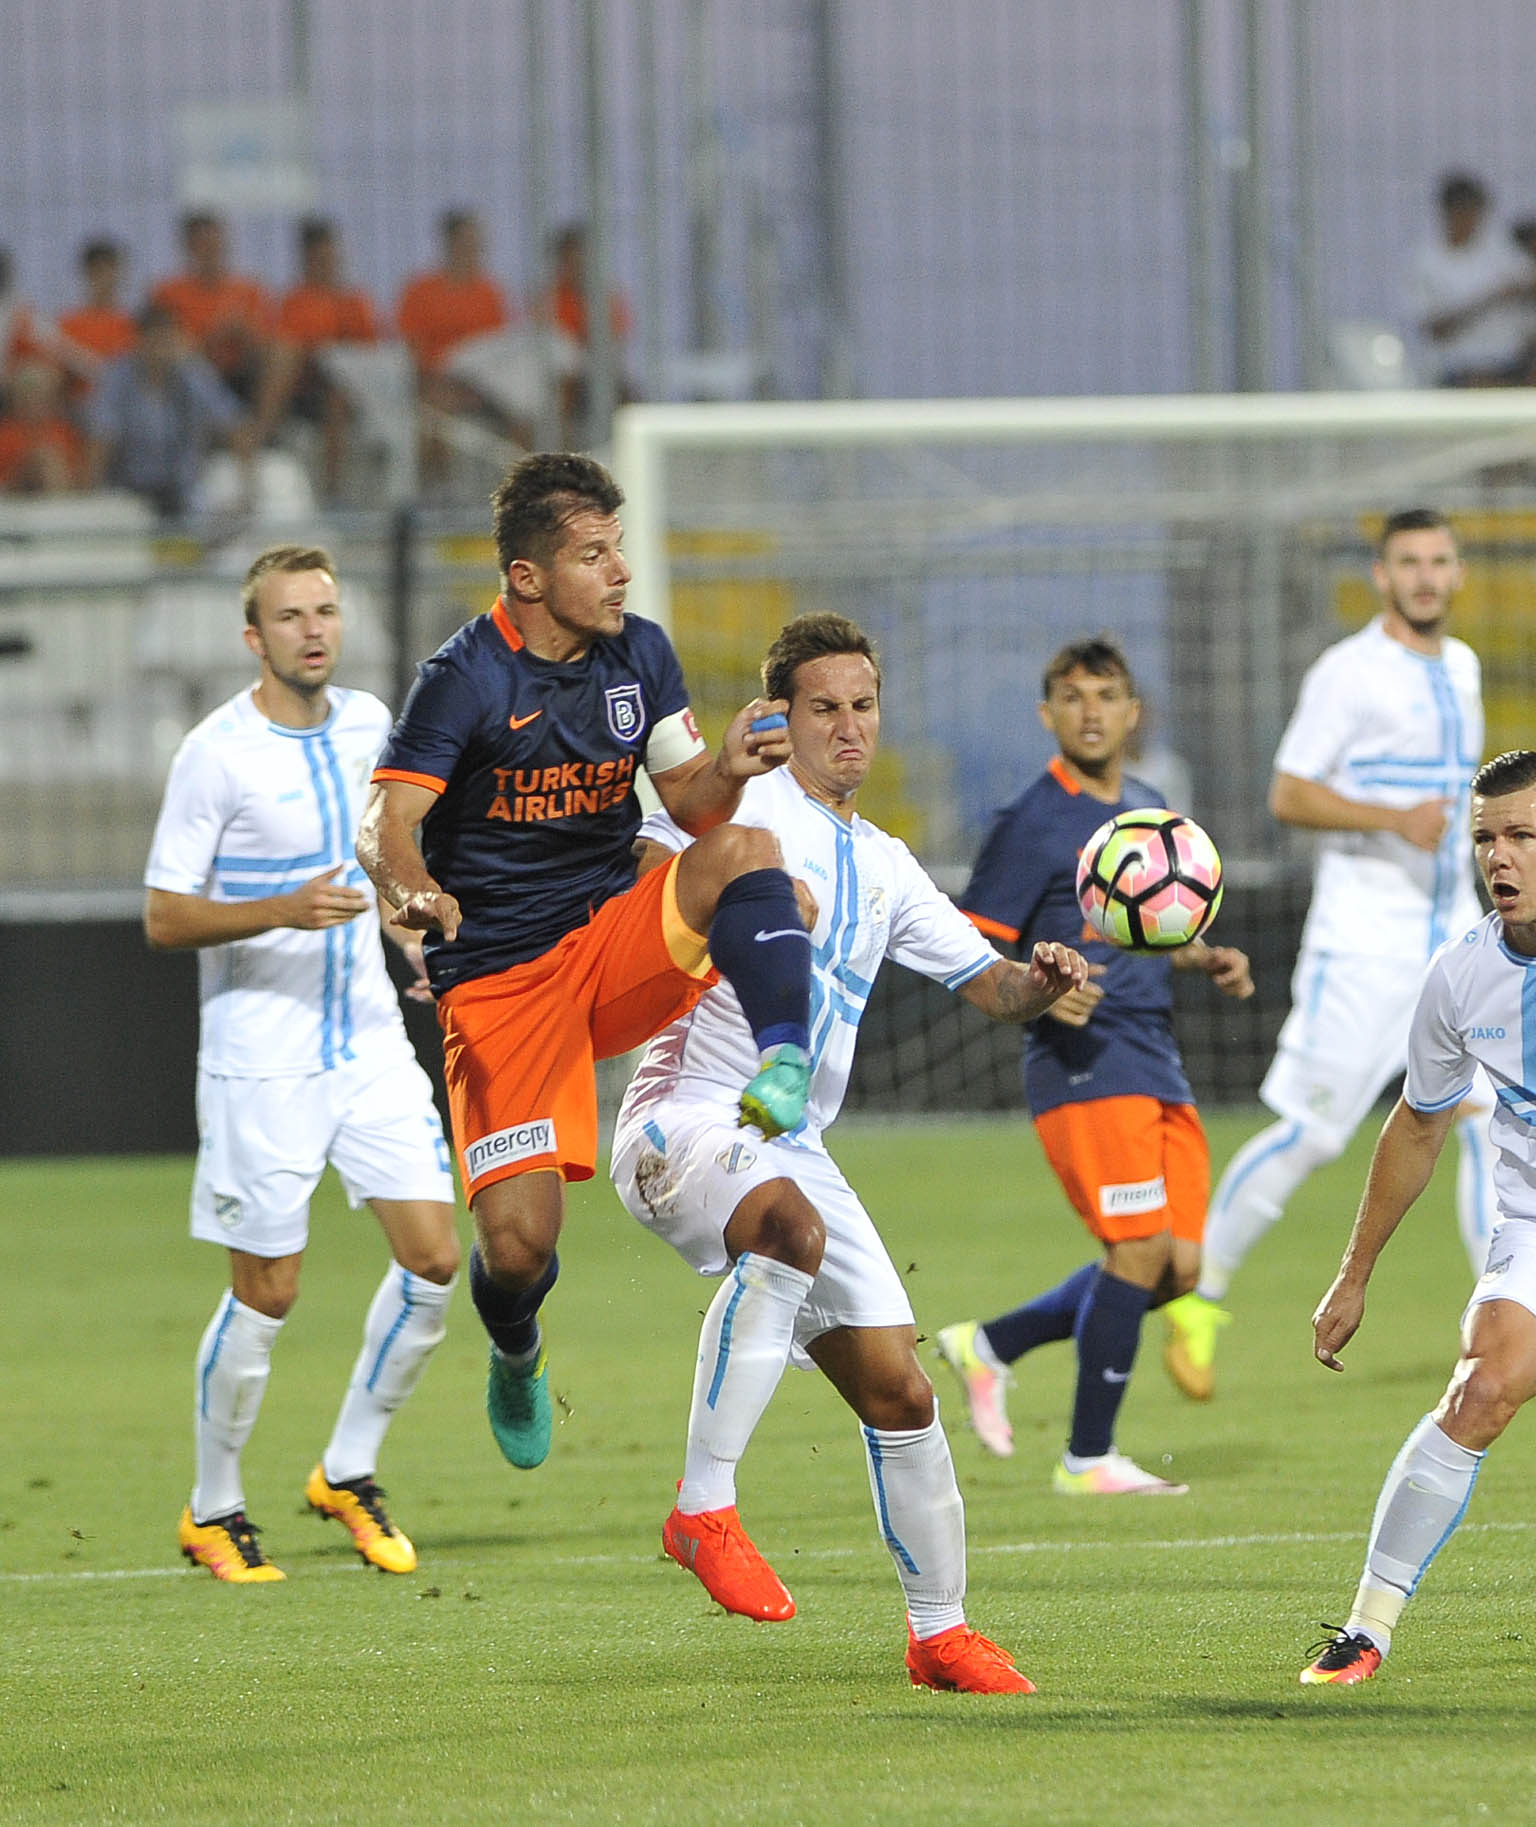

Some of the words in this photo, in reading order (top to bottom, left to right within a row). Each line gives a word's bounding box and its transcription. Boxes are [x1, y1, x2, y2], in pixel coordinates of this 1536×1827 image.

[493, 753, 634, 794] TURKISH
[485, 781, 632, 823] AIRLINES
[1471, 1027, 1506, 1040] JAKO
